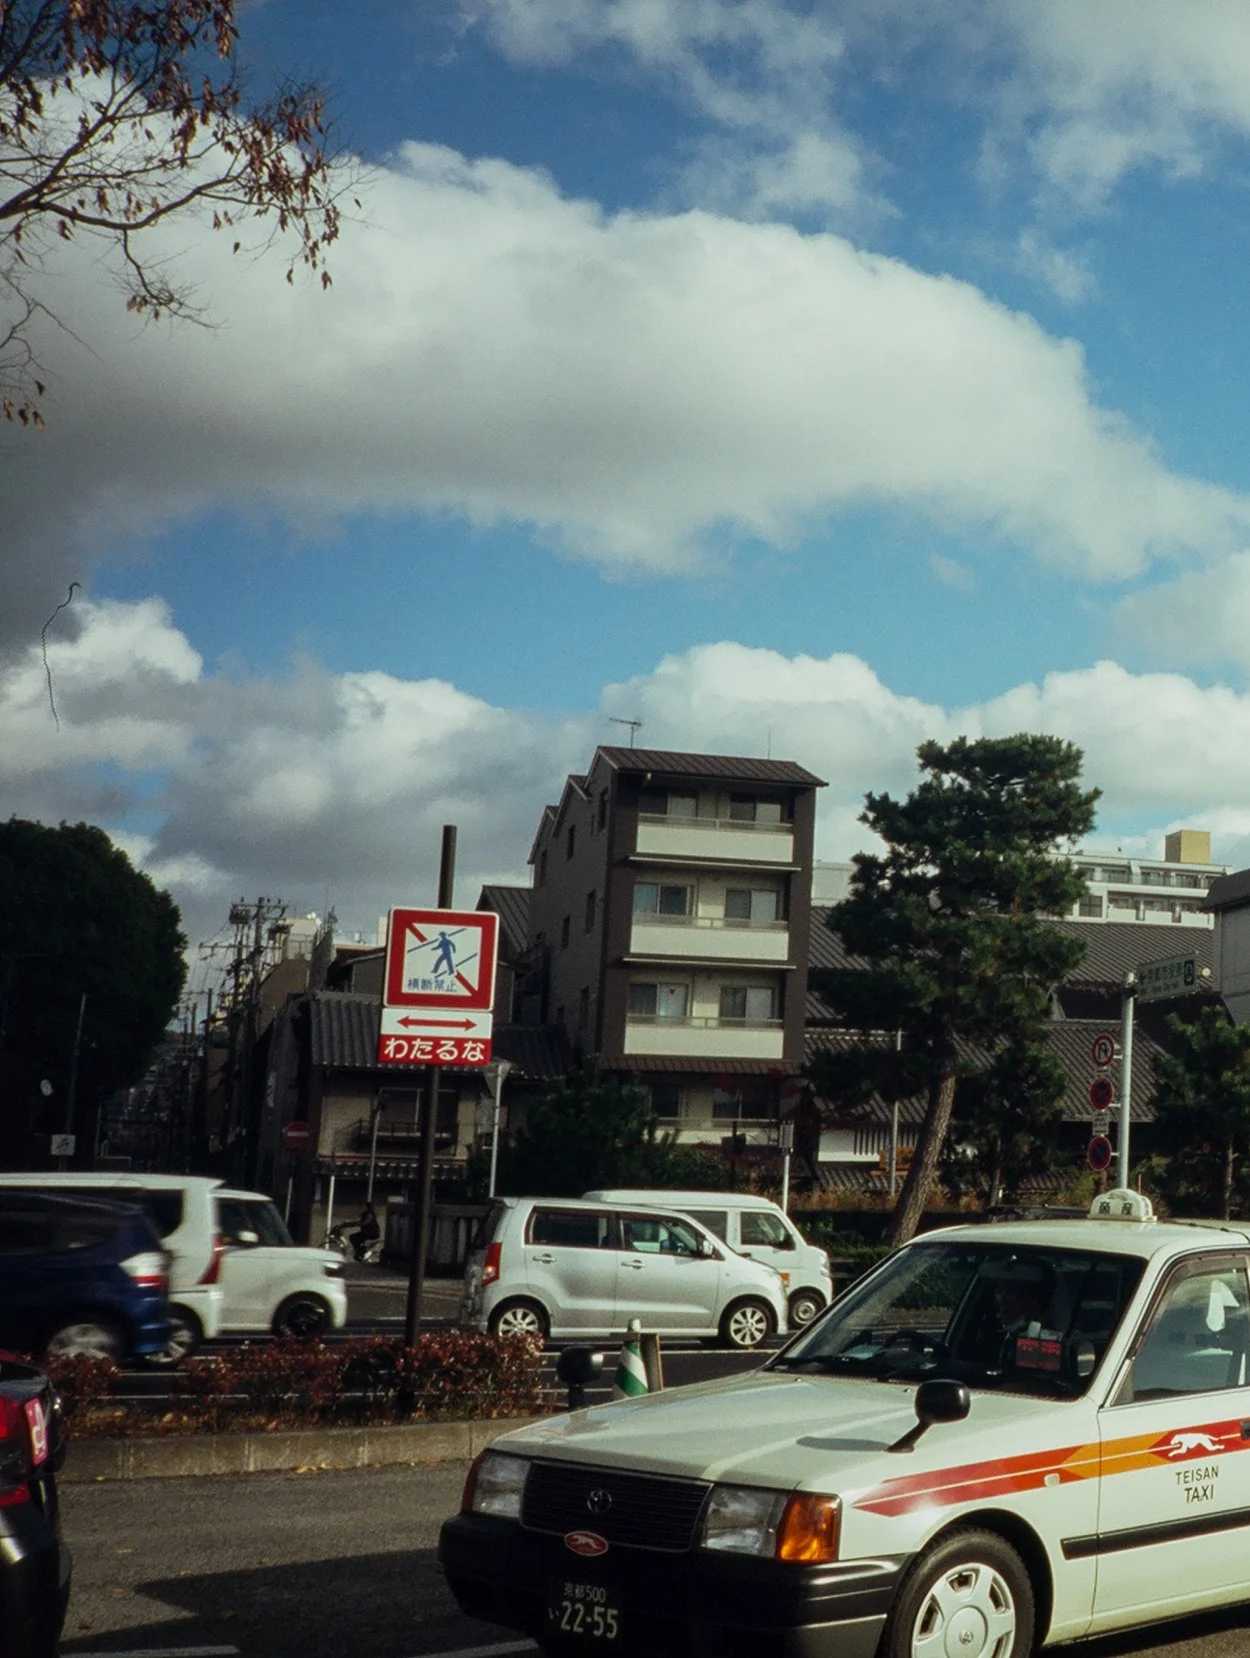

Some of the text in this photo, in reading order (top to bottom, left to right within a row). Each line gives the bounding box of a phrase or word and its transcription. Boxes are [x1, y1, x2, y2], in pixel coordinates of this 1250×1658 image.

[407, 977, 458, 992] 横断禁止
[384, 1037, 485, 1062] わたるな
[1175, 1465, 1219, 1485] TEISAN
[1184, 1484, 1214, 1503] TAXI
[561, 1600, 618, 1639] 22-55
